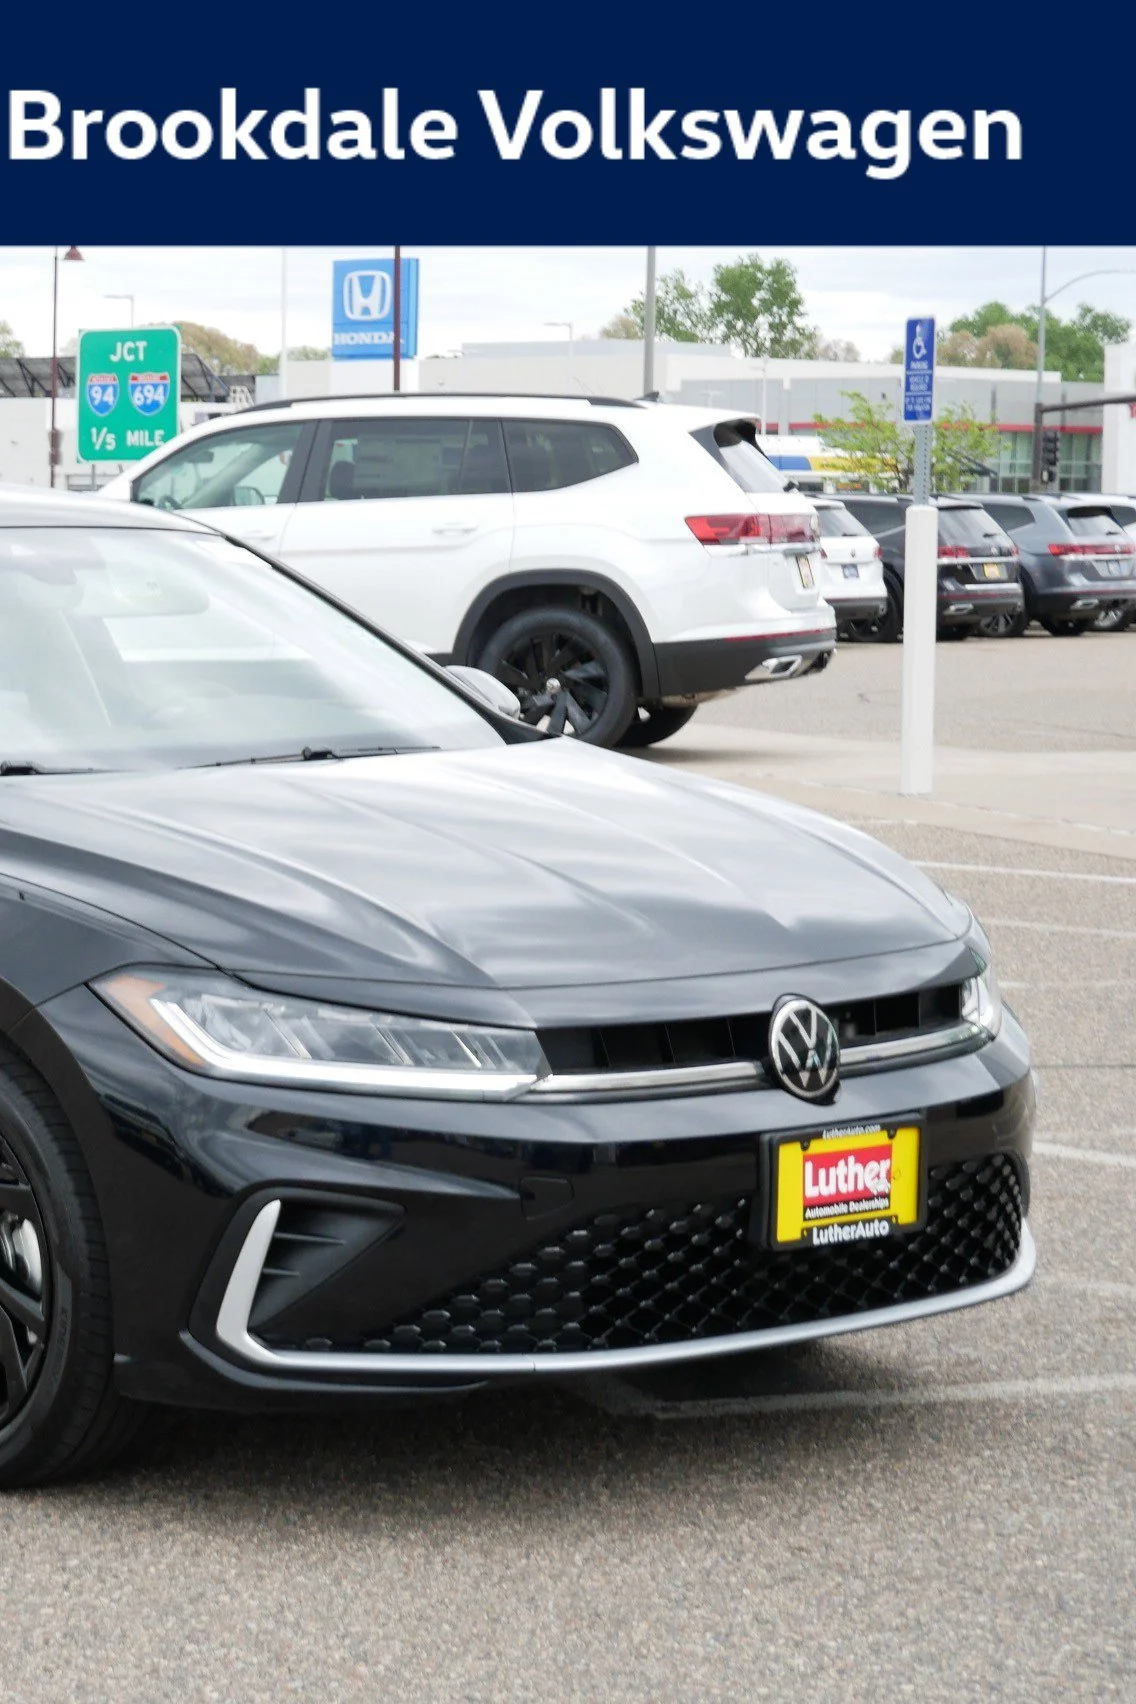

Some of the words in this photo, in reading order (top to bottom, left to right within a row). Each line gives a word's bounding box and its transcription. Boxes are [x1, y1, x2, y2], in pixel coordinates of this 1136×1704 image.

[109, 341, 147, 362] JCT
[90, 385, 115, 406] 94
[134, 384, 165, 407] 694
[126, 430, 165, 447] MILE
[805, 1155, 891, 1199] Luther
[805, 1203, 848, 1219] Automobile
[849, 1197, 889, 1213] Dealerships
[813, 1219, 890, 1246] LutherAuto
